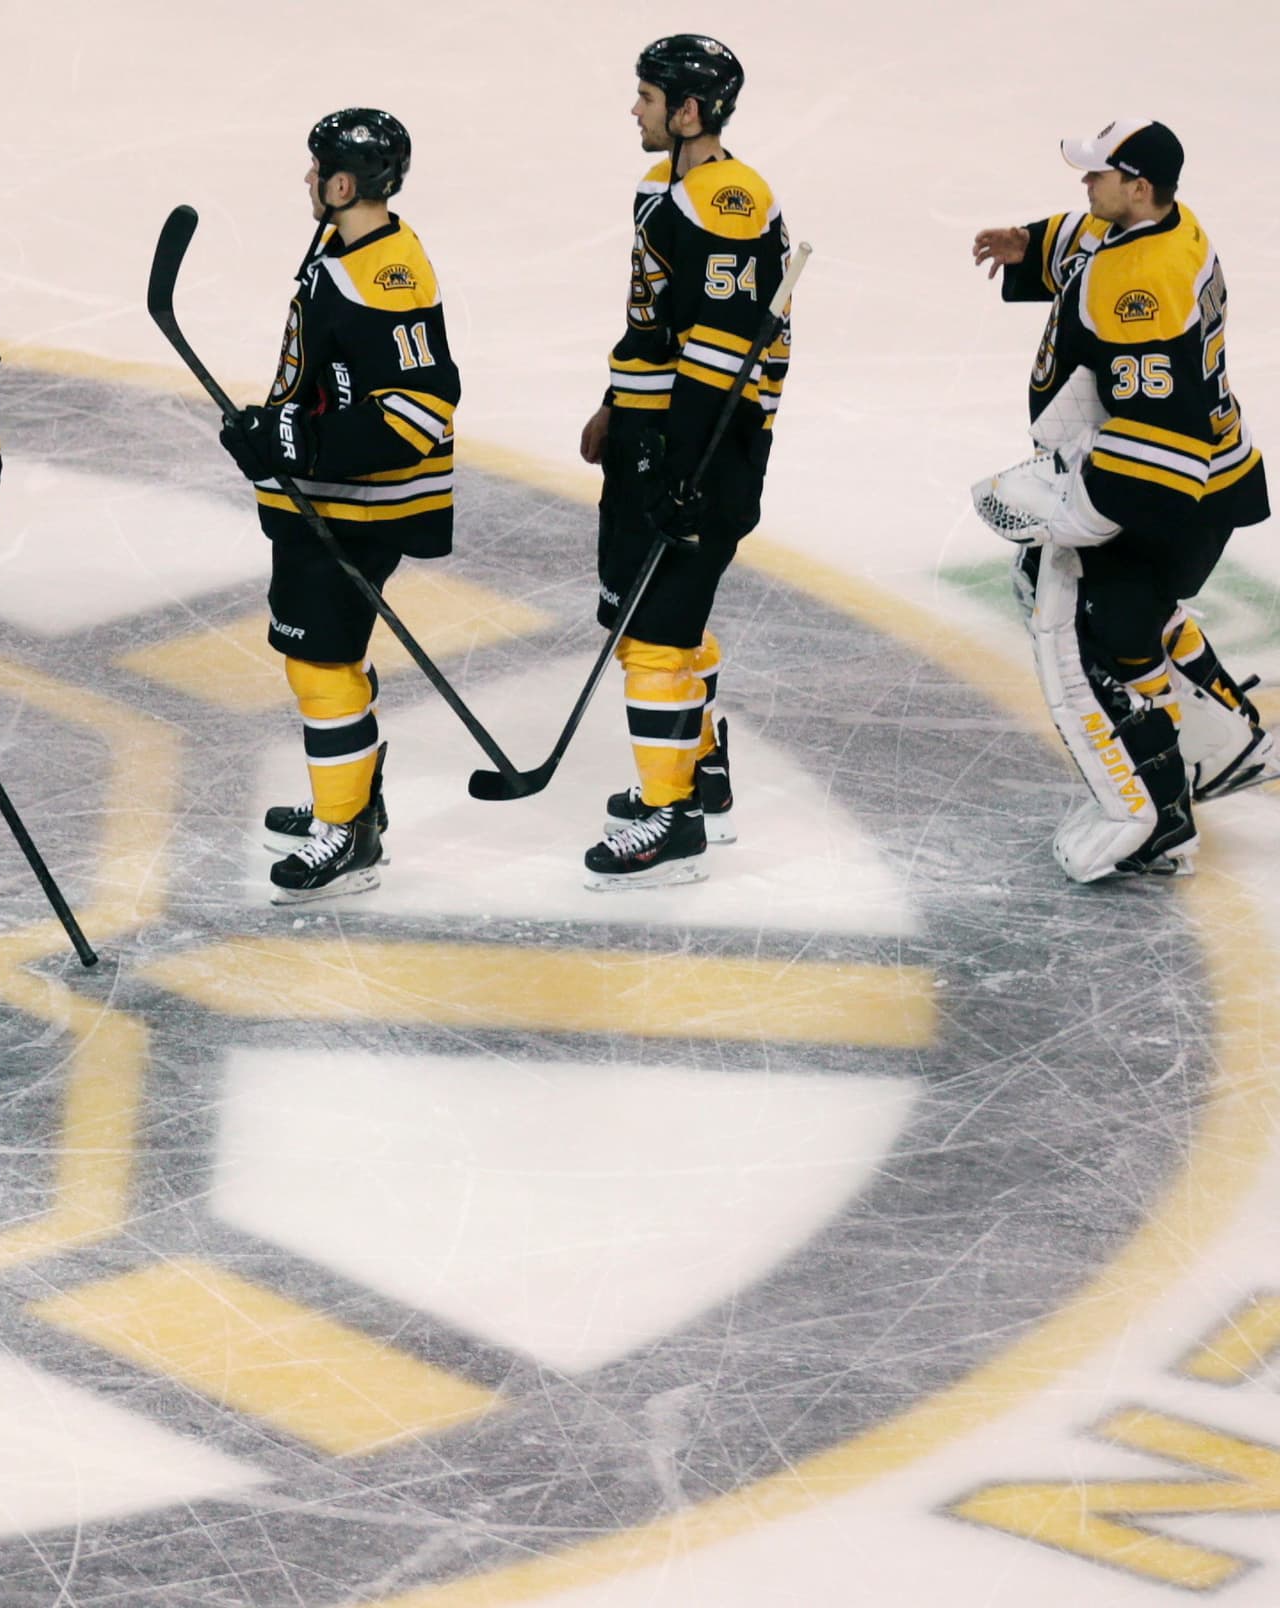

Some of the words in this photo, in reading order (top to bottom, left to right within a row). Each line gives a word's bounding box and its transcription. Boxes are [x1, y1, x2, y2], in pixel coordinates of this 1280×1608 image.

[704, 253, 758, 301] 54
[392, 321, 436, 371] 11
[331, 362, 352, 410] UER
[1110, 353, 1174, 400] 35
[1079, 711, 1148, 815] VAUGHN
